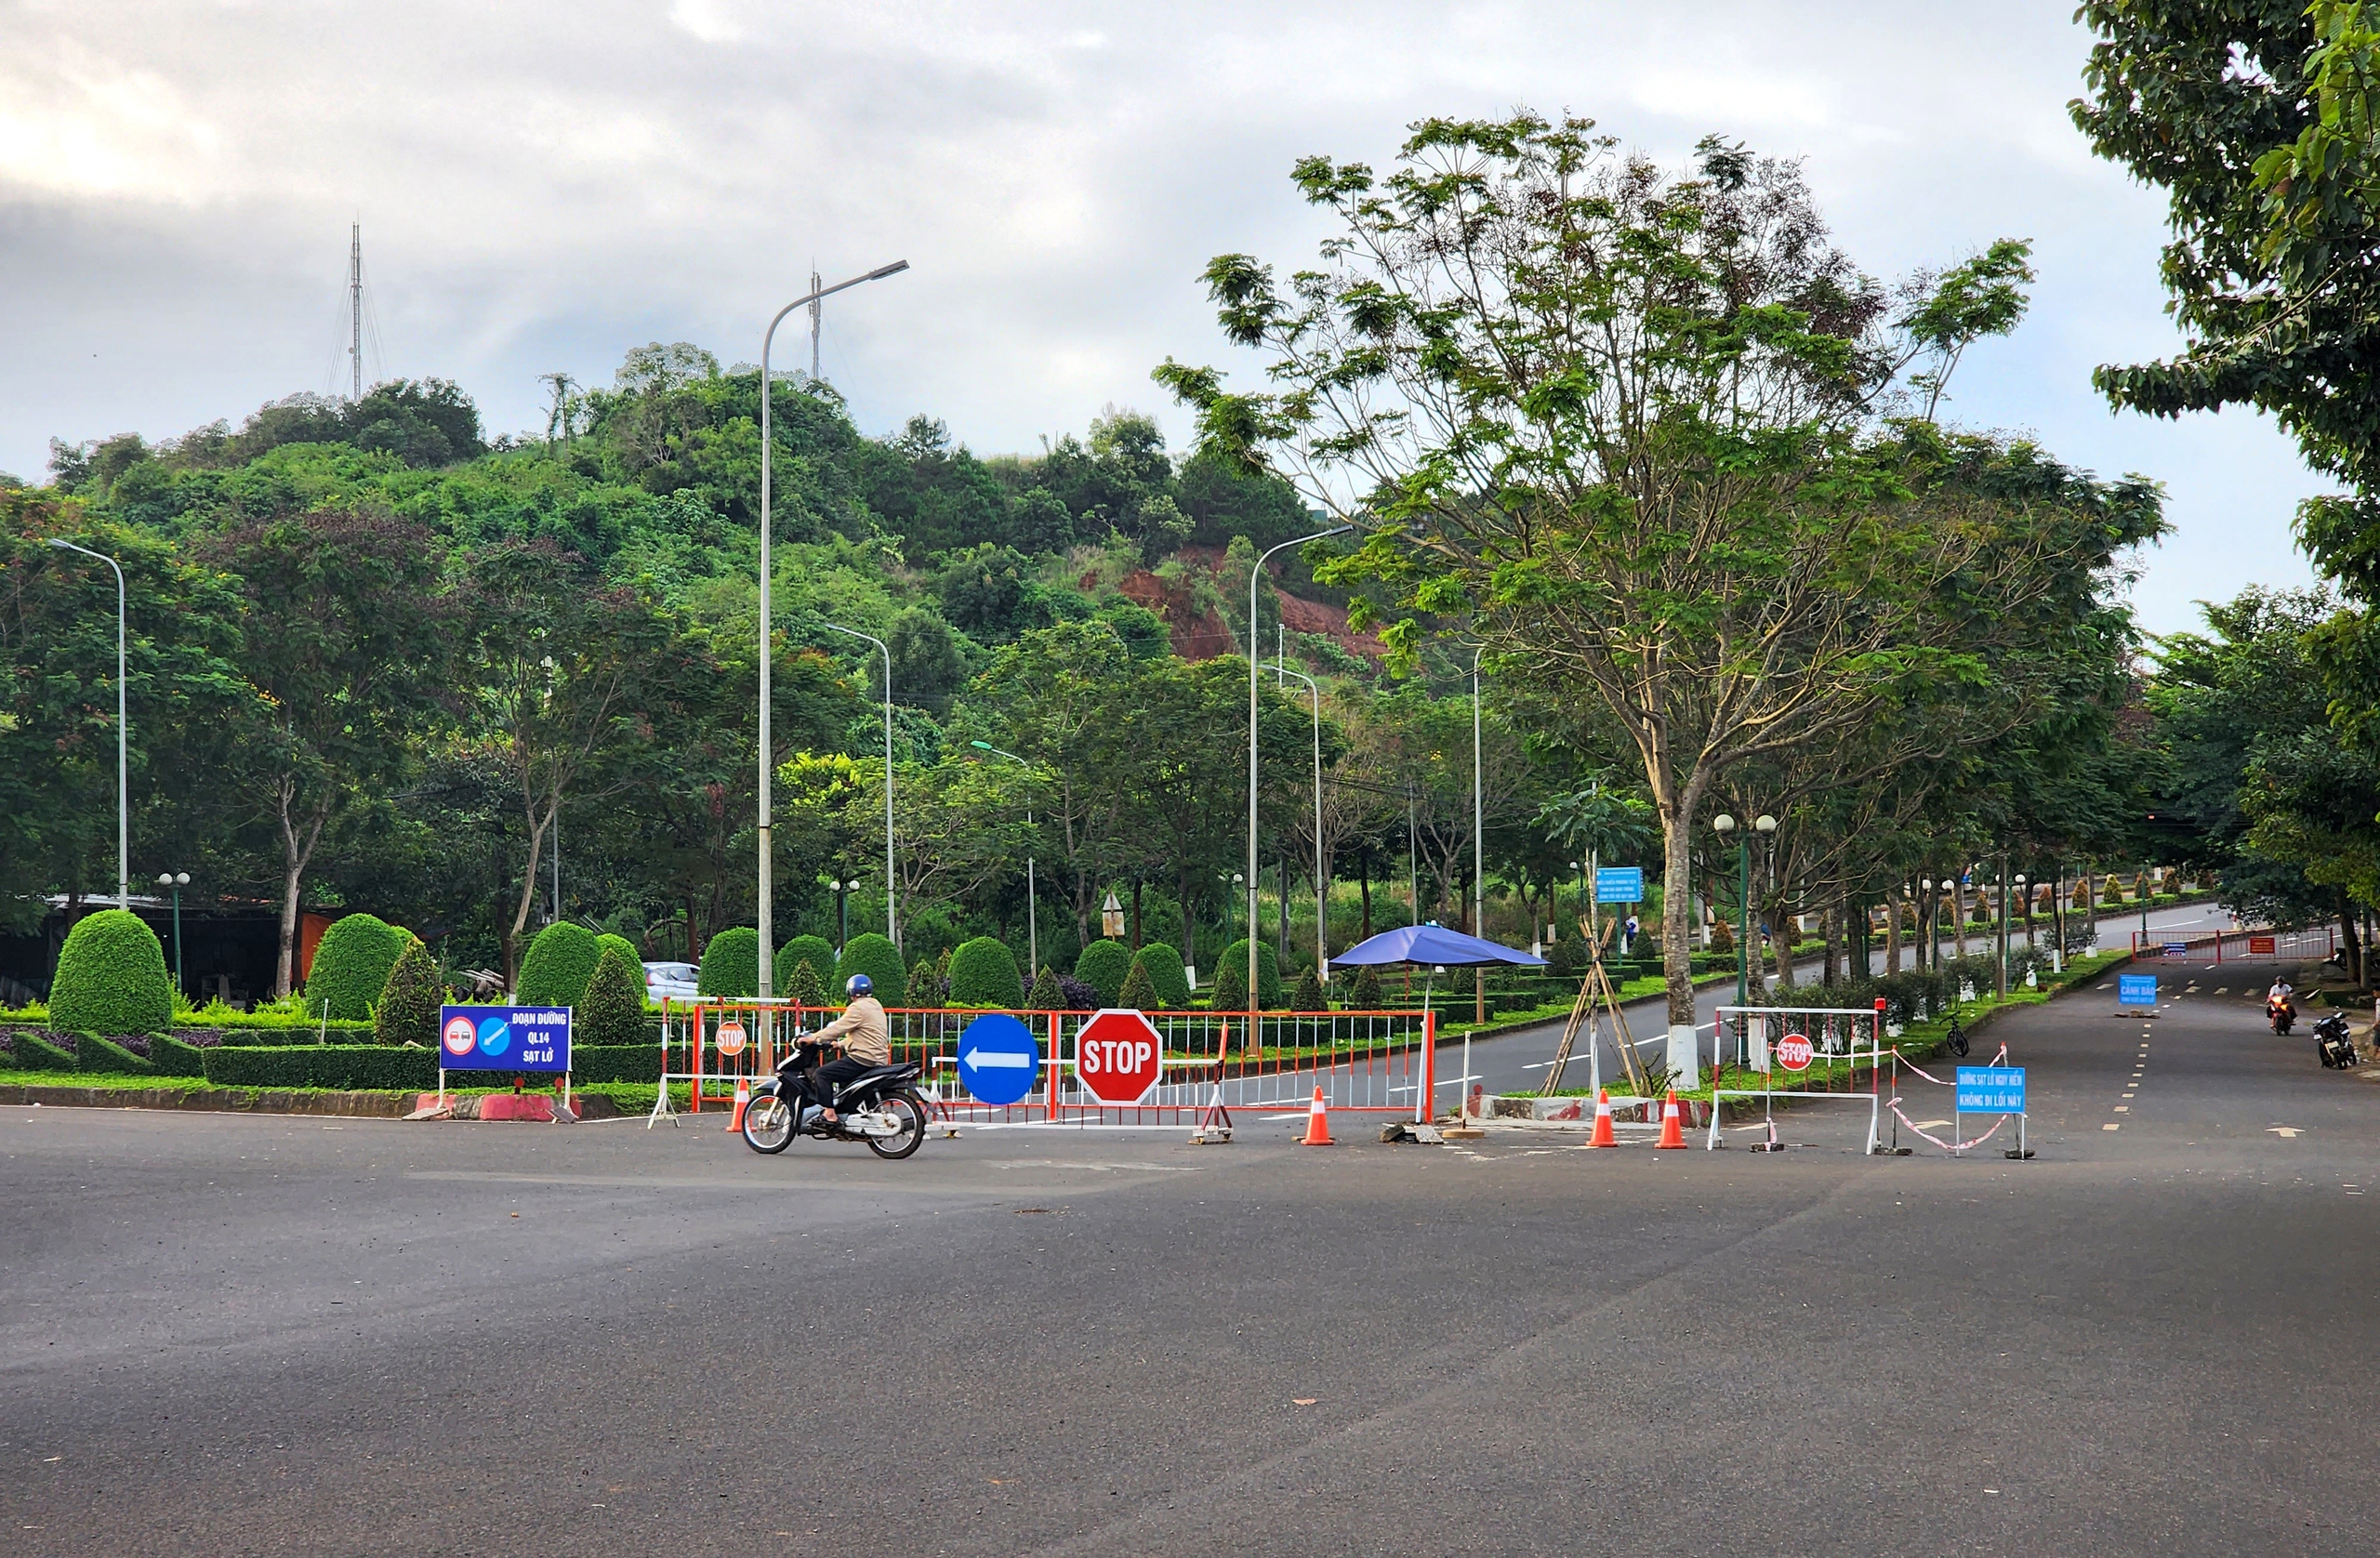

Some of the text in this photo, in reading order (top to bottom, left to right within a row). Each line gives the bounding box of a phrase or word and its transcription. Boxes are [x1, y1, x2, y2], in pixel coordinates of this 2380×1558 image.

[512, 1010, 567, 1027] ĐOẠN ĐƯỜNG
[527, 1031, 550, 1045] QL14
[718, 1029, 745, 1048] STOP
[522, 1047, 554, 1064] SẠT LỞ
[1084, 1039, 1152, 1074] STOP
[1779, 1041, 1811, 1063] STOP
[1959, 1090, 2022, 1107] KHÔNG ĐI LỐI NÀY
